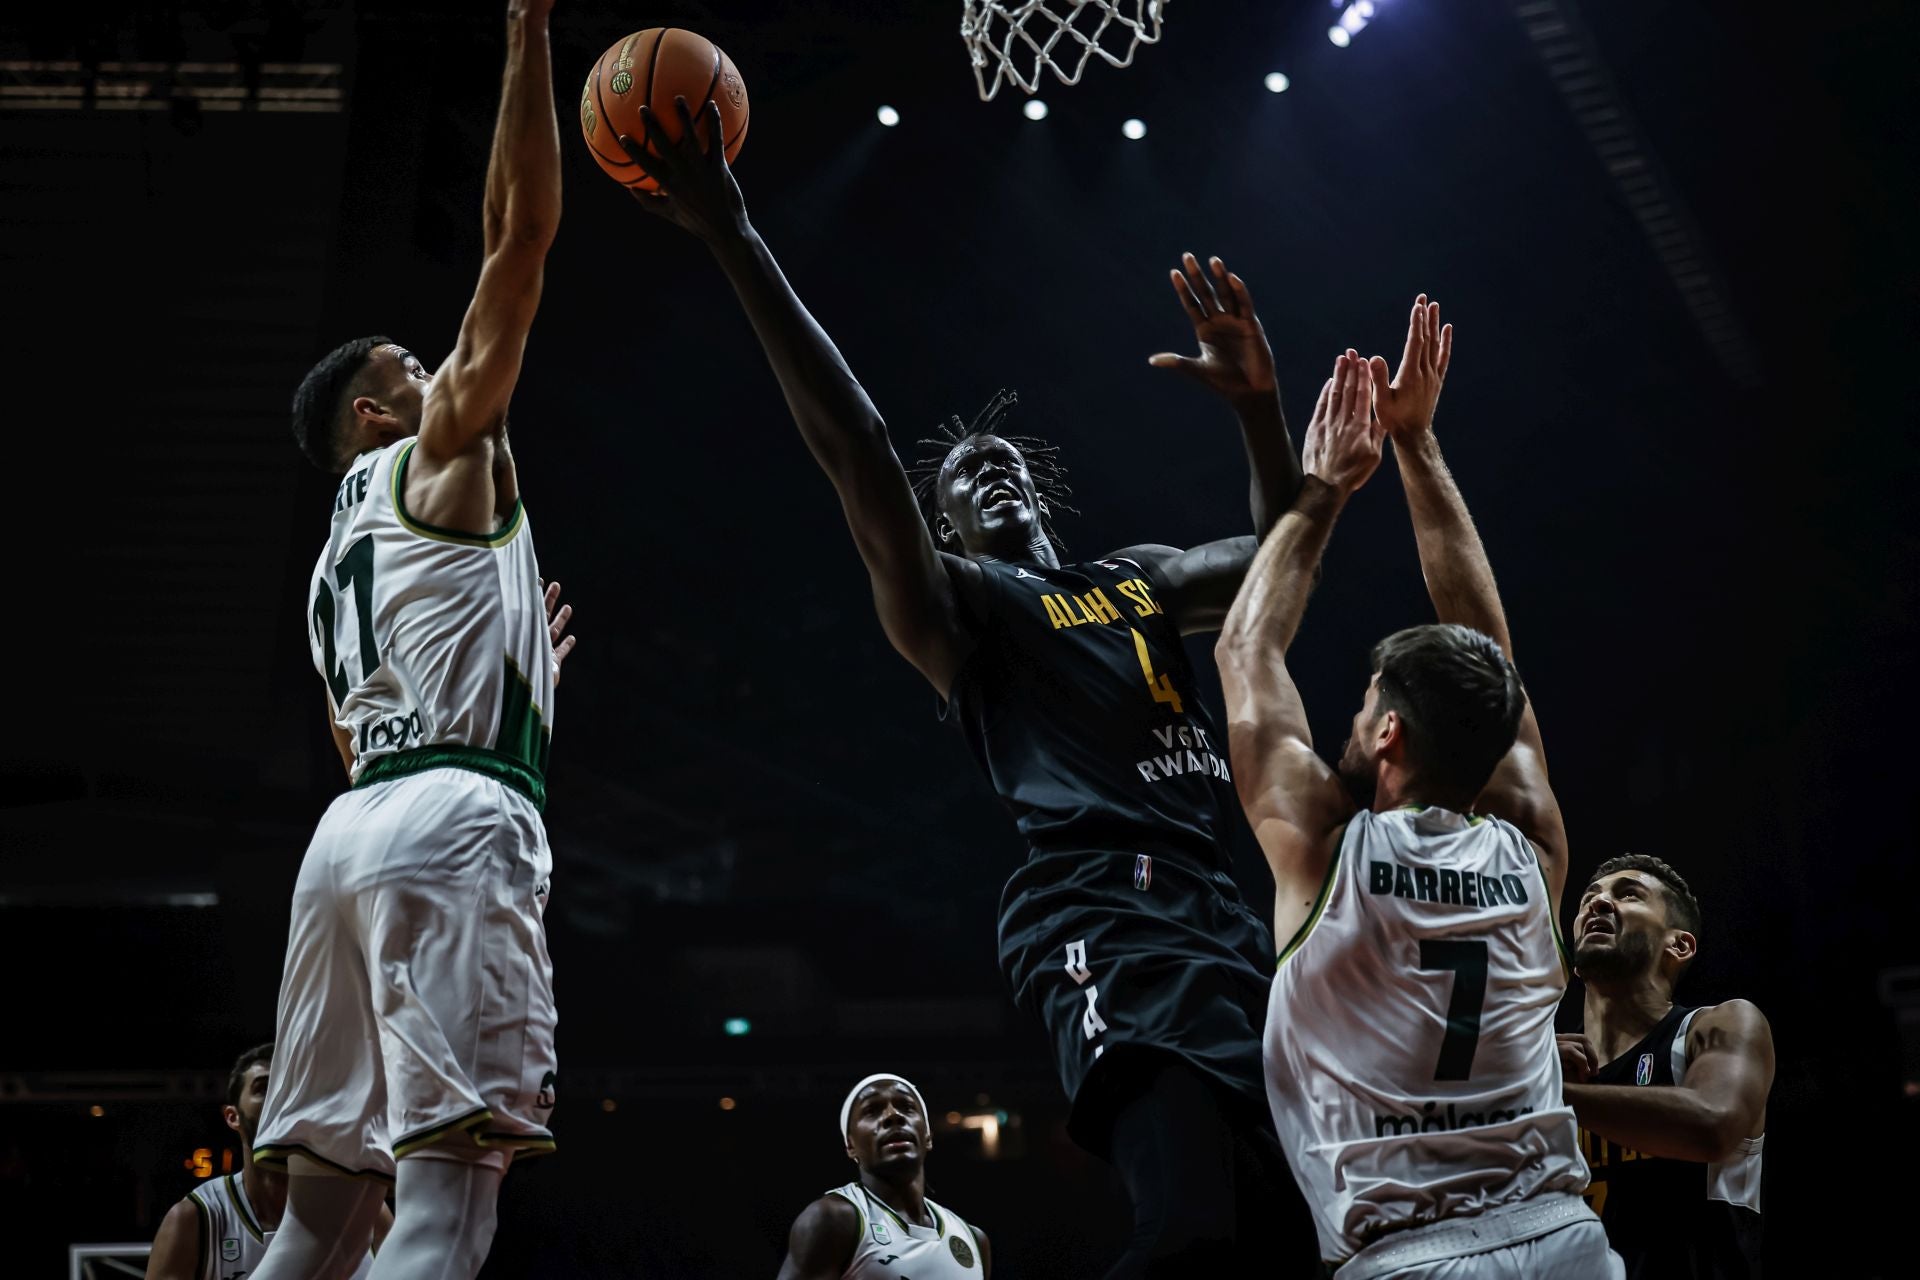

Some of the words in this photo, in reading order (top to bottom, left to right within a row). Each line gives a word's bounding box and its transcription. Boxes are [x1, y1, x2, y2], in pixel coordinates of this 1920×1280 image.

[1130, 627, 1184, 714] 4
[1152, 725, 1209, 750] VSIT
[1136, 749, 1231, 783] RWANDA
[1370, 861, 1528, 908] BARREIRO
[1420, 940, 1488, 1081] 7
[1376, 1102, 1533, 1137] mála
